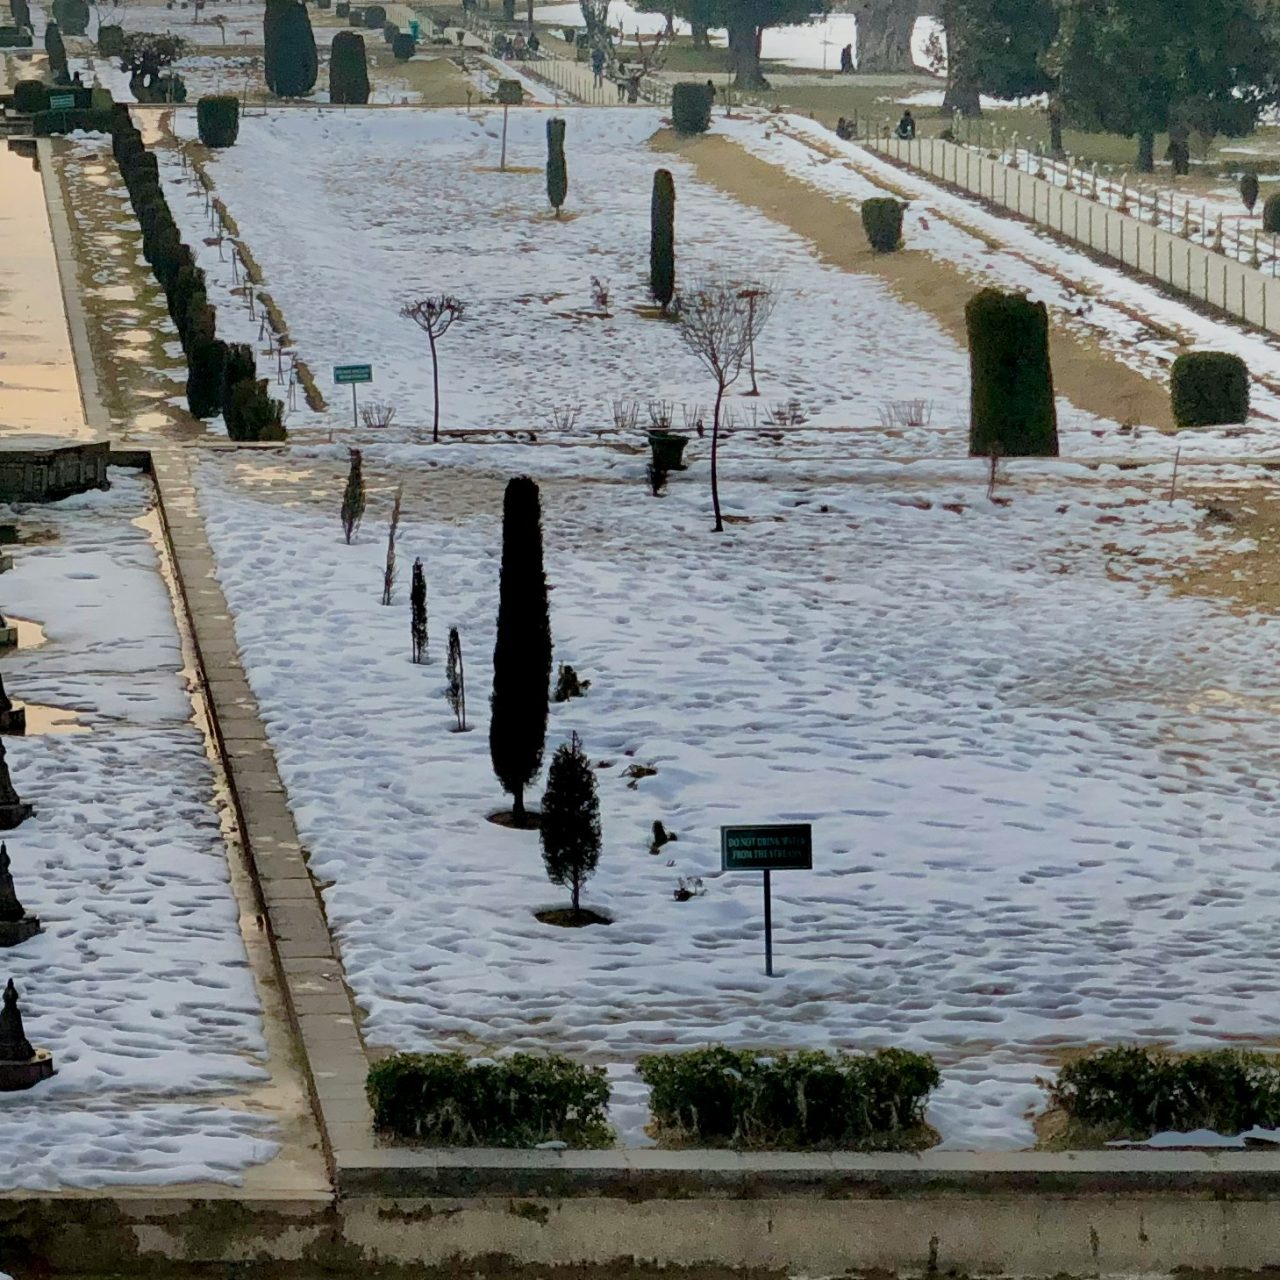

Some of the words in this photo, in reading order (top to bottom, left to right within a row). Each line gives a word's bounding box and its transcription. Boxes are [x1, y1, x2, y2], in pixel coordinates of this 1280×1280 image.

[728, 838, 740, 848] DO
[741, 837, 755, 847] NOT
[732, 849, 753, 860] FROM
